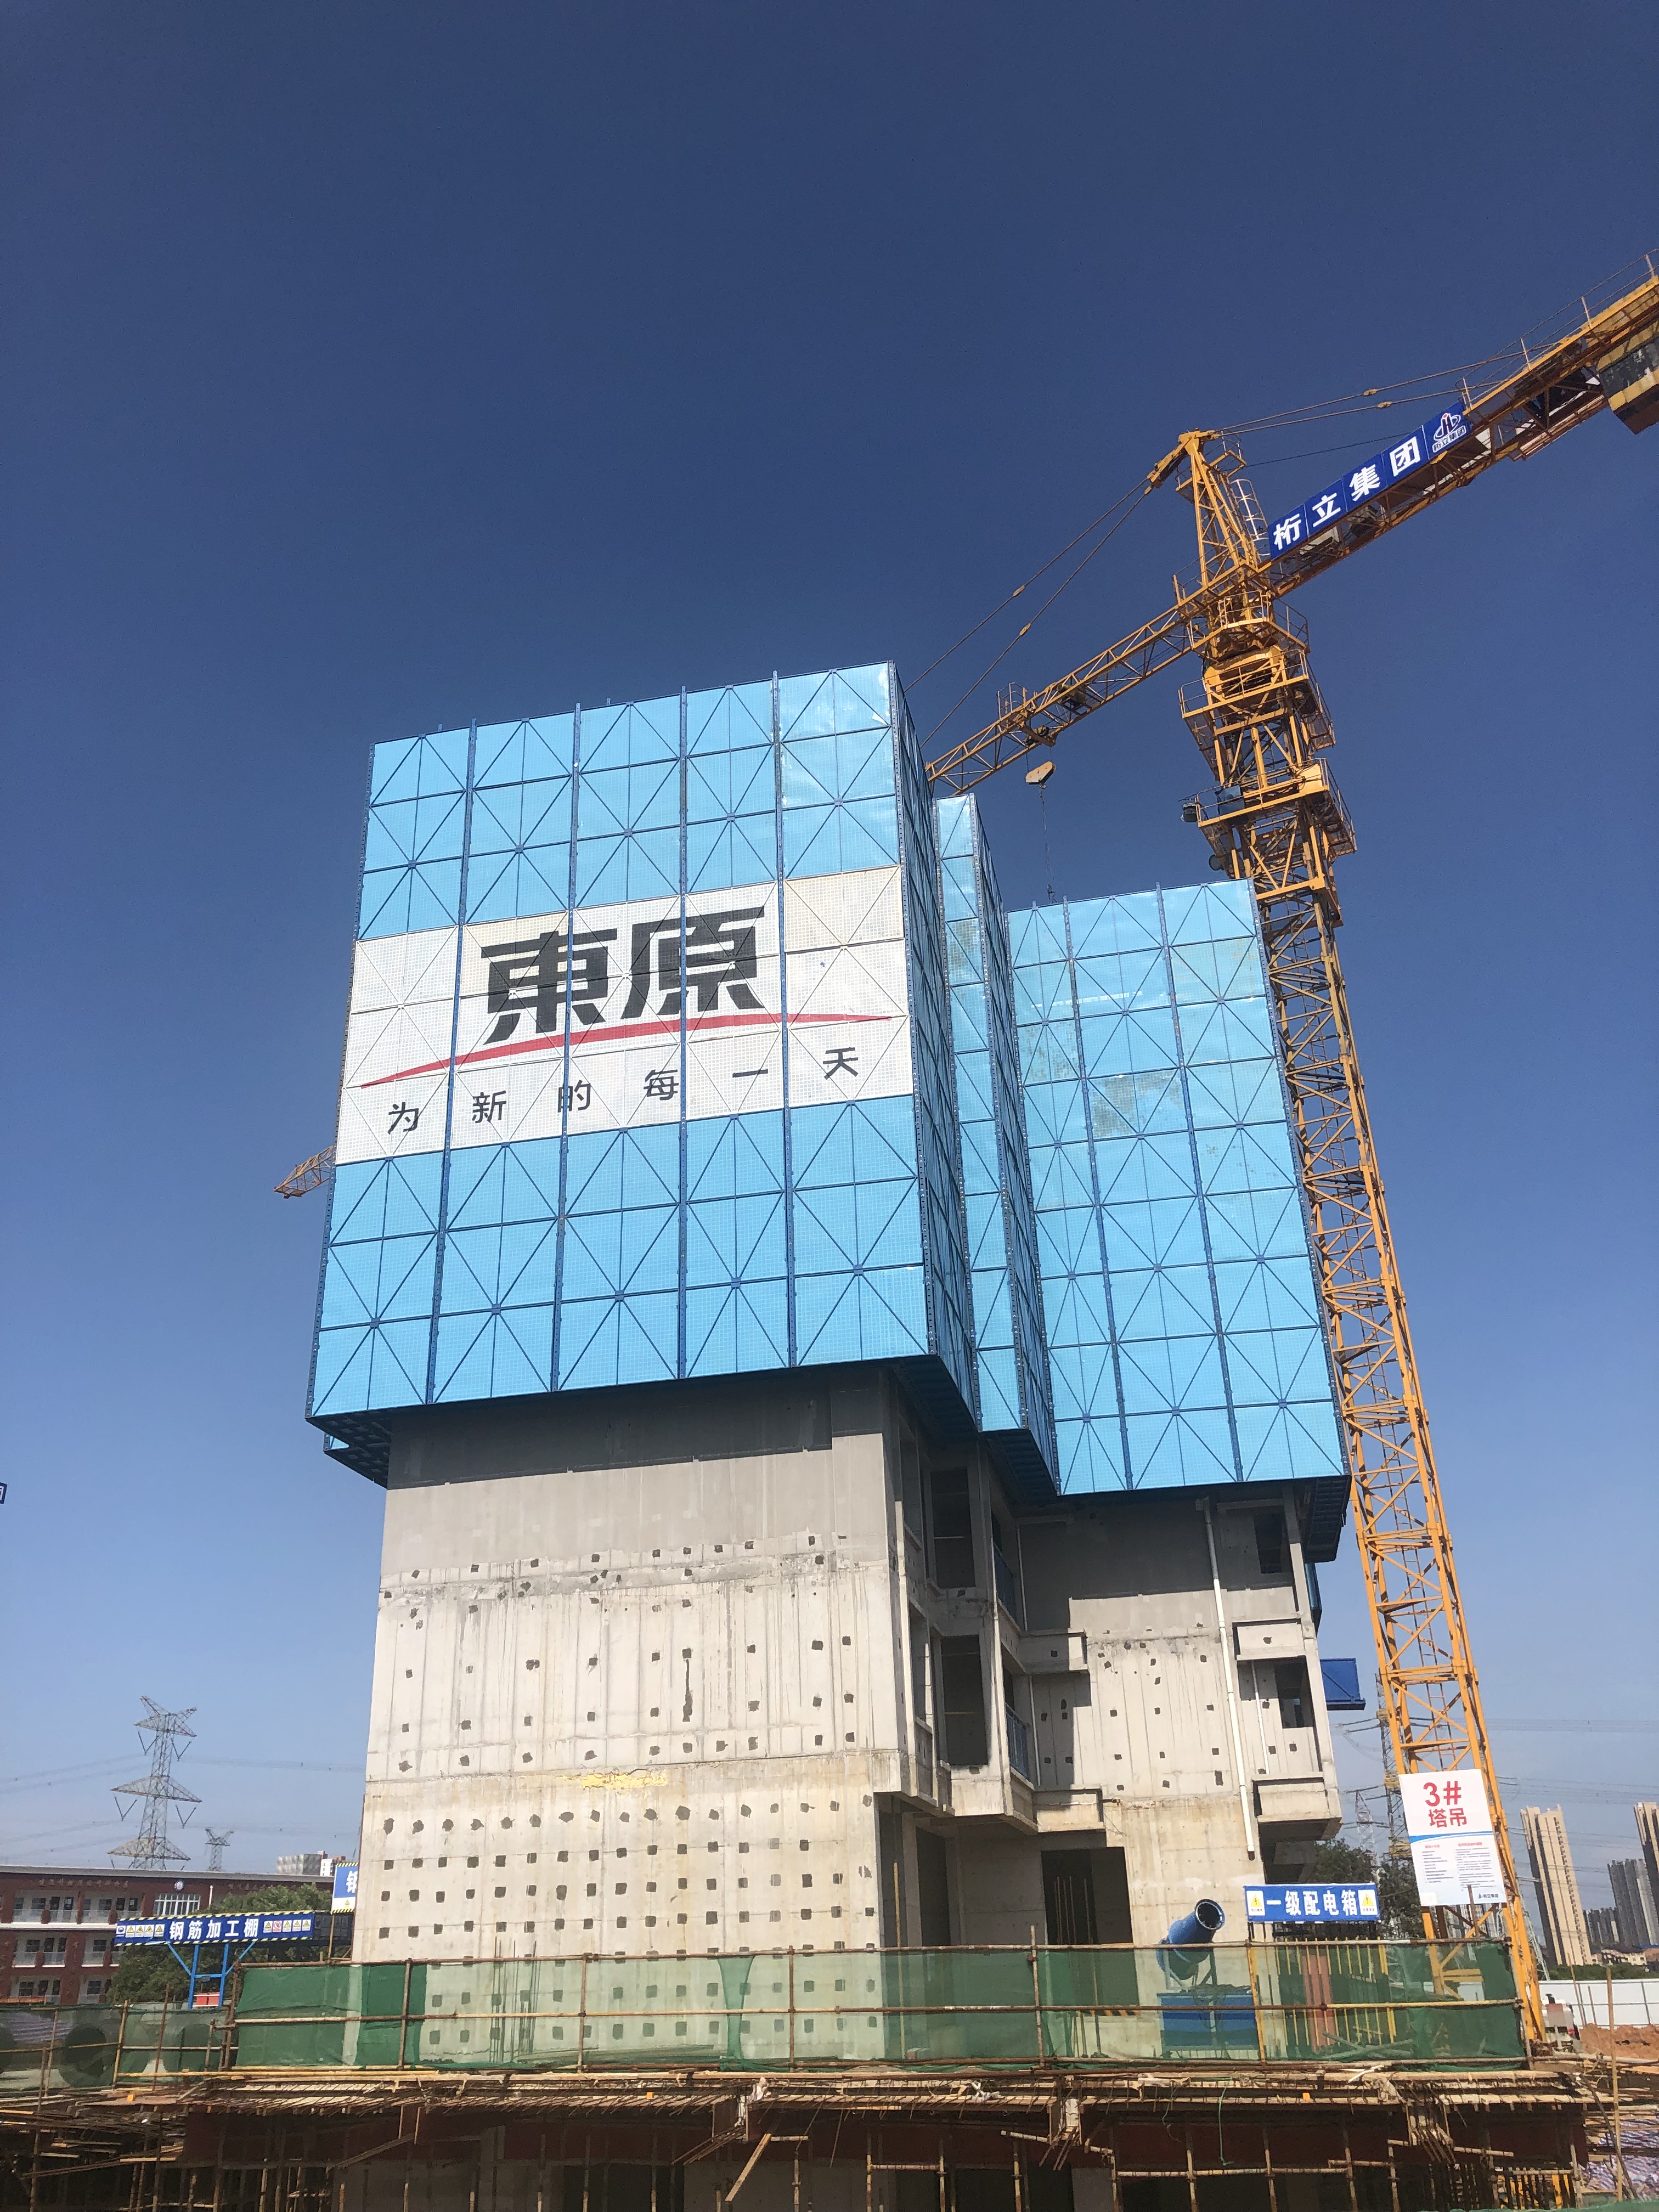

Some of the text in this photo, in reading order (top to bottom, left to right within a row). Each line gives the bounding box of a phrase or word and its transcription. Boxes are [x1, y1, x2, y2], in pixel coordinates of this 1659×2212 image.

[1273, 437, 1420, 550] 桁立集团
[481, 901, 765, 1045] 東原
[388, 1047, 858, 1133] 为新的每一天
[1423, 1780, 1462, 1807] 3#
[1428, 1808, 1467, 1828] 塔吊
[1266, 1889, 1358, 1916] 一级配电箱
[169, 1918, 259, 1940] 钢筋加工棚
